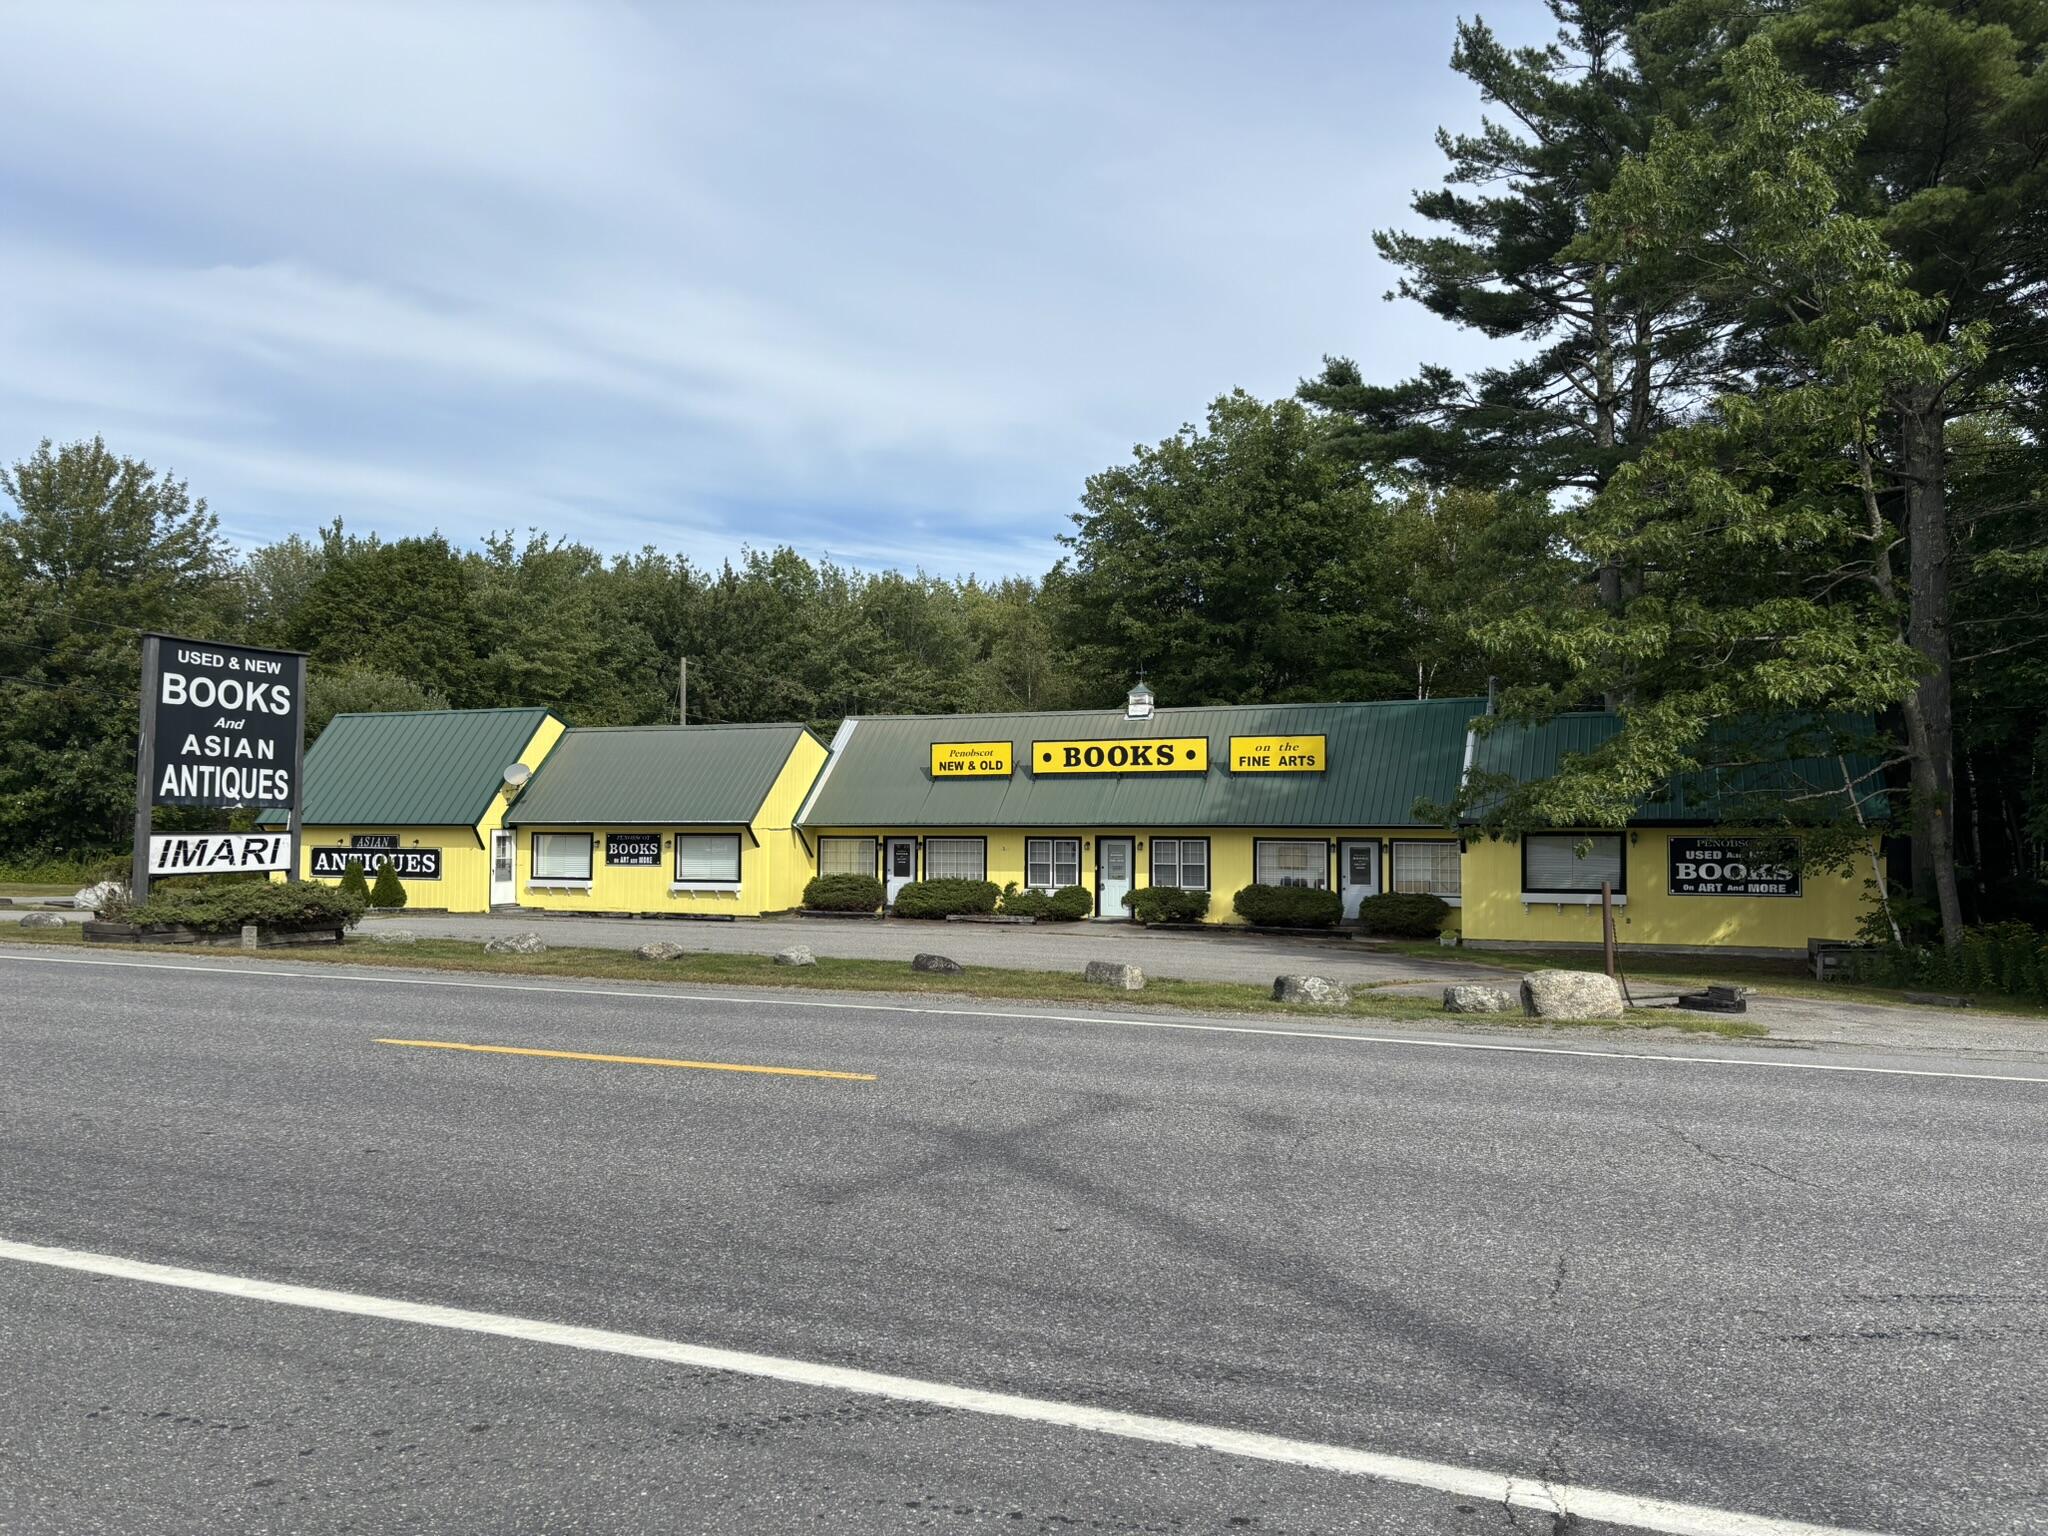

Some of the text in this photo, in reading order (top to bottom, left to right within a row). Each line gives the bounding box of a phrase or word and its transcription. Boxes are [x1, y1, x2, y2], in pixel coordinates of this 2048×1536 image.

[177, 649, 282, 674] USED & NEW
[162, 671, 291, 716] BOOKS
[214, 717, 245, 730] And
[180, 734, 274, 760] ASIAN
[1255, 741, 1300, 752] on the
[949, 748, 994, 758] Penobscot
[1063, 744, 1175, 768] BOOKS
[939, 760, 1003, 772] NEW & OLD
[1239, 755, 1316, 767] FINE ARTS
[159, 764, 289, 801] ANTIQUES
[356, 836, 390, 847] ASIAN
[157, 837, 281, 869] IMARI
[609, 843, 658, 854] BOOKS
[1685, 850, 1722, 860] USED
[1675, 862, 1793, 881] BOOKS
[1683, 883, 1786, 893] On ART And MORE
